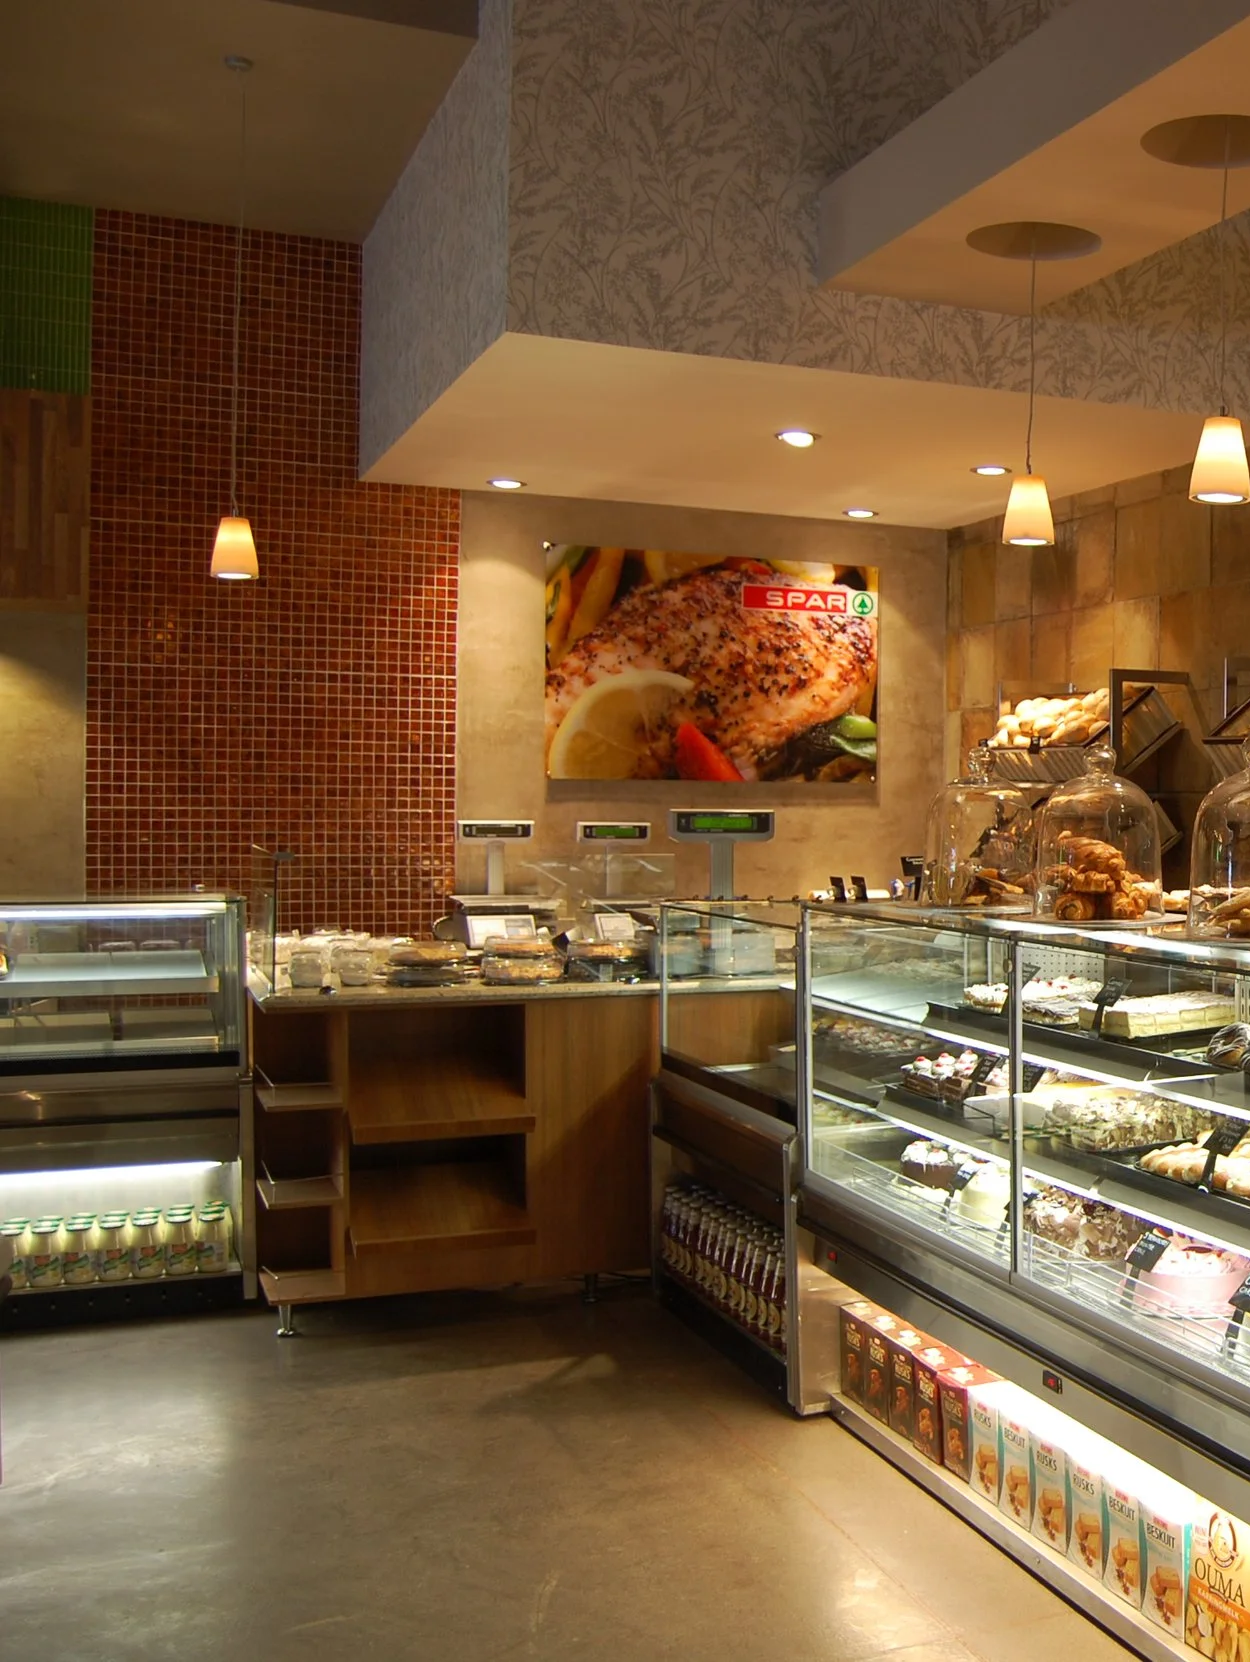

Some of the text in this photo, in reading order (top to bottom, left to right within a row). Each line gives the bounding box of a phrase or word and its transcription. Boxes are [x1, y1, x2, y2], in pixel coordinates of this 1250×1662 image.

[766, 590, 846, 611] SPAR
[1036, 1450, 1057, 1471] RUSKS
[1073, 1473, 1095, 1495] RUSKS
[1109, 1495, 1135, 1521] BESKUIT
[1147, 1522, 1176, 1549] BESKUIT
[1195, 1557, 1246, 1608] OUMA
